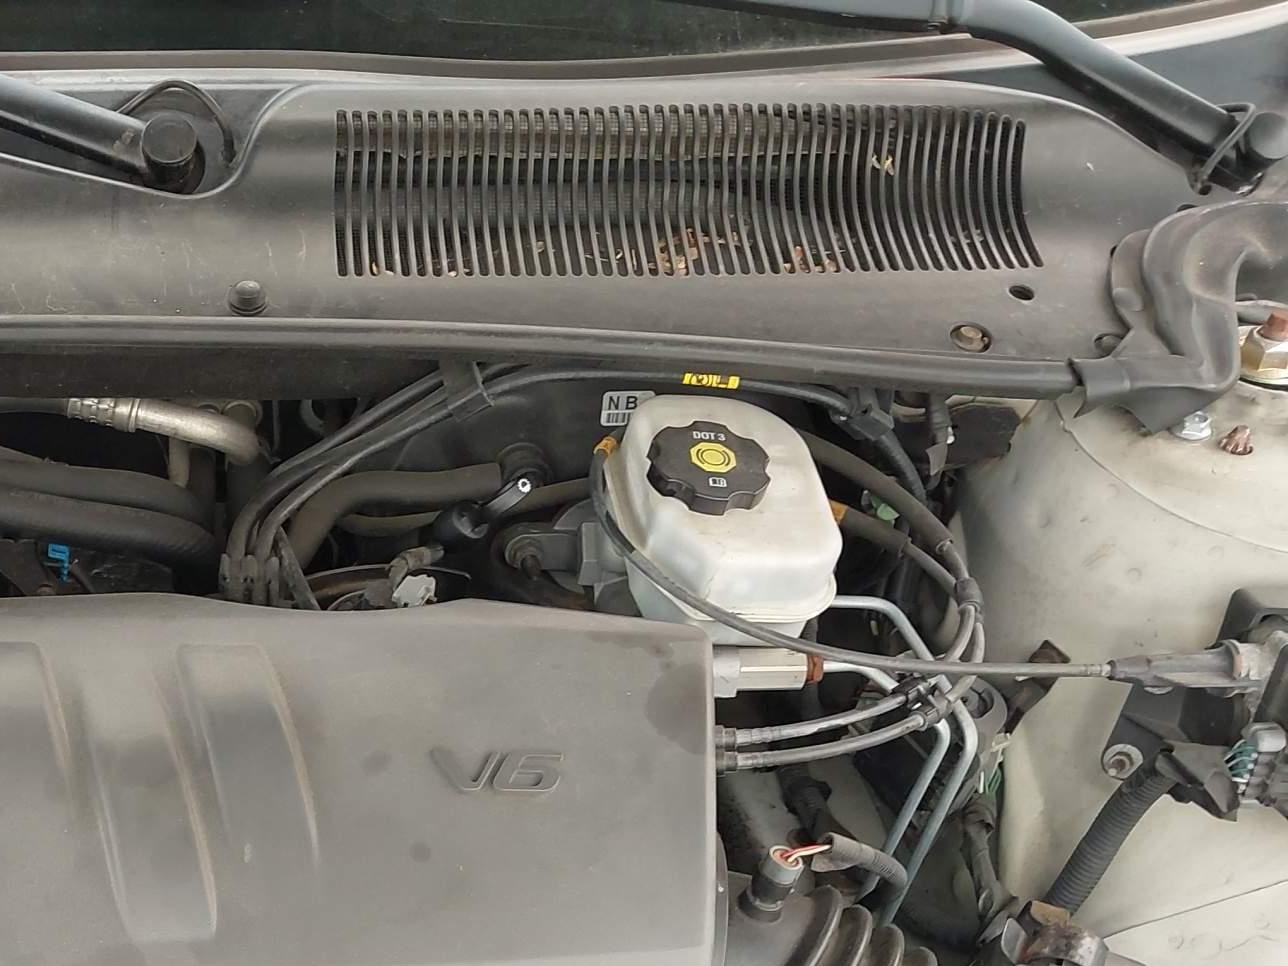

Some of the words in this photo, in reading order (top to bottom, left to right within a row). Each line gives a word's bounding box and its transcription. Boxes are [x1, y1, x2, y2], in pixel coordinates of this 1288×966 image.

[693, 431, 715, 440] DOT
[718, 433, 726, 442] 3
[429, 747, 563, 793] V6
